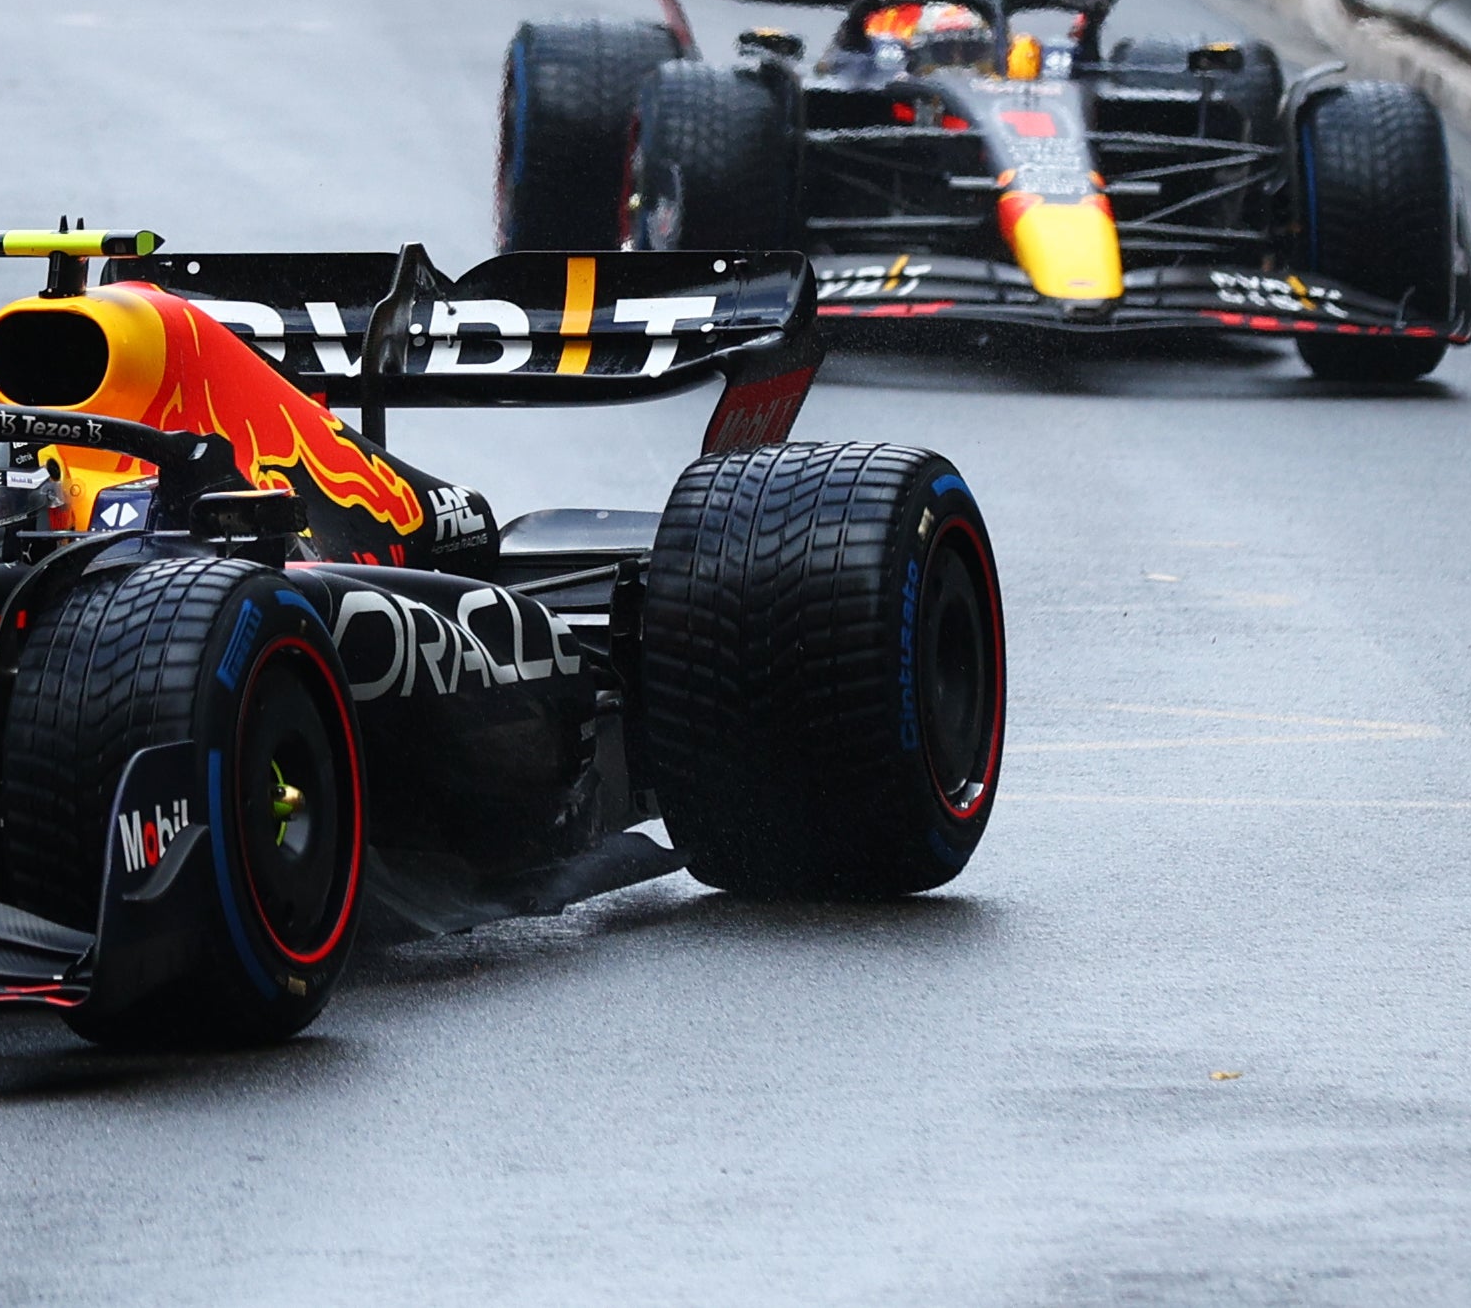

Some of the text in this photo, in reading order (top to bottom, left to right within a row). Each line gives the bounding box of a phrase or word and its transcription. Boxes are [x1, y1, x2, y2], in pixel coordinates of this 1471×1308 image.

[22, 415, 82, 439] Tezos
[460, 533, 489, 549] RACING
[331, 586, 581, 702] ORACLE
[118, 798, 190, 873] Mobil
